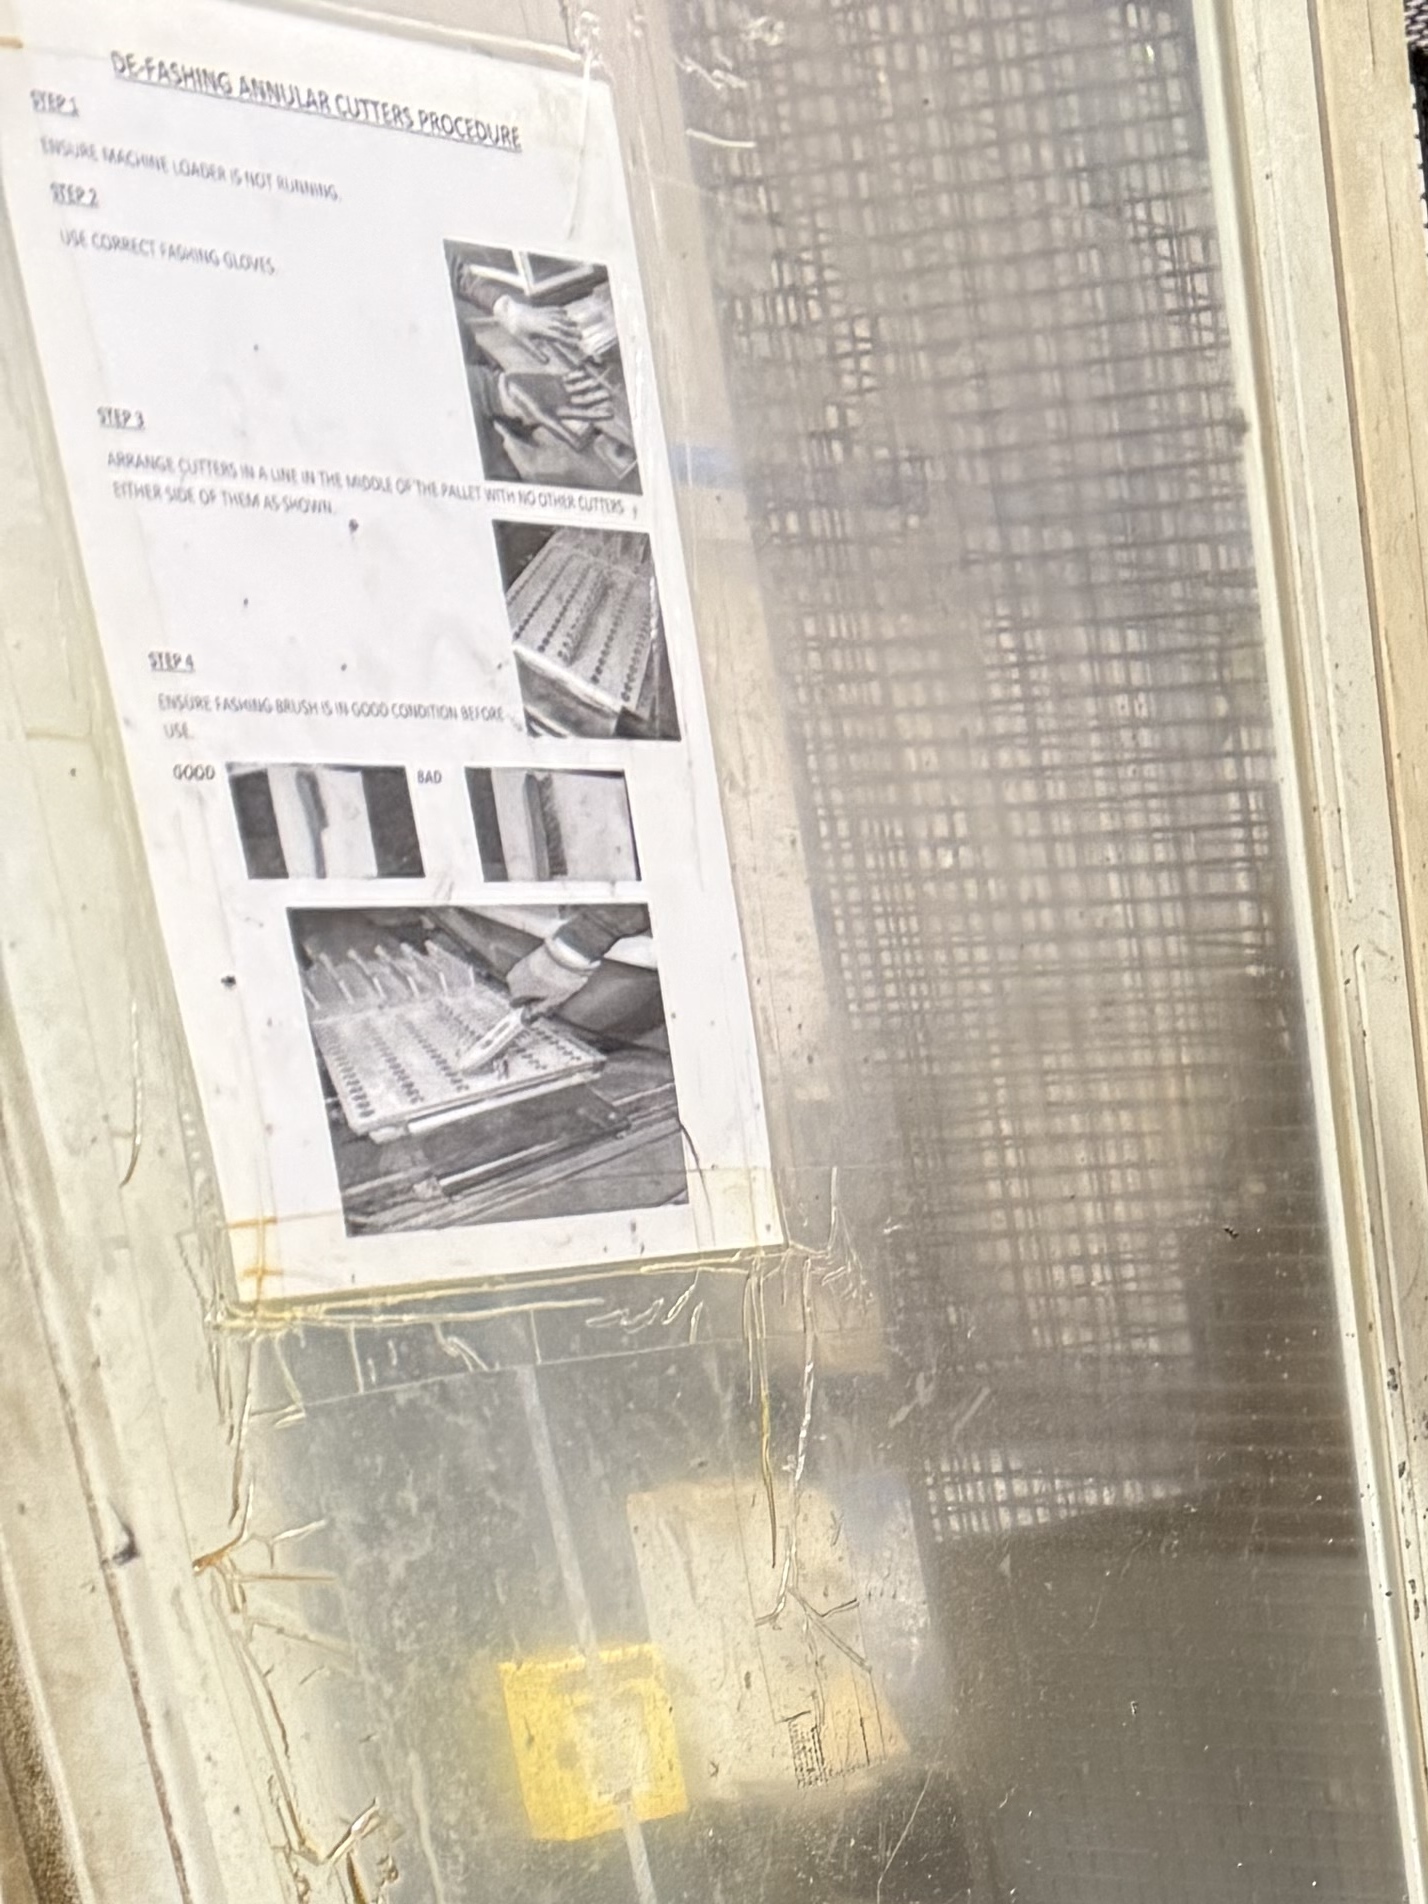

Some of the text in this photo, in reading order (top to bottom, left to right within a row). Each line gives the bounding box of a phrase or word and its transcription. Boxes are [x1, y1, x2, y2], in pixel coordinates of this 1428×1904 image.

[30, 89, 66, 113] STEP
[239, 76, 331, 113] ANNULAR
[334, 93, 414, 129] CUTTERS
[418, 109, 522, 150] PROCEDURE
[40, 137, 98, 162] ENSURE
[102, 146, 169, 174] MACHINE
[172, 158, 226, 182] LOADER
[230, 170, 241, 186] IS
[245, 171, 273, 192] NOT
[50, 181, 99, 206] STEP 2
[60, 227, 87, 248] USE
[91, 231, 156, 258] CORRECT
[96, 405, 145, 430] STEP 3
[107, 451, 175, 475] ARRANGE
[177, 457, 237, 480] CUTTERS
[240, 464, 255, 481] IN
[258, 466, 268, 482] A
[271, 467, 298, 485] LINE
[301, 469, 316, 486] IN
[318, 471, 343, 490] THE
[346, 475, 392, 494] MIDDLE
[395, 477, 412, 496] OF
[415, 479, 438, 498] THE
[440, 483, 481, 502] PALLET
[484, 487, 516, 505] WITH
[518, 490, 536, 506] NO
[538, 490, 576, 510] OTHER
[578, 498, 625, 515] CUTTERS
[113, 481, 162, 502] EITHER
[164, 486, 195, 504] SIDE
[200, 488, 217, 506] OF
[221, 492, 261, 510] THEM
[264, 495, 281, 512] AS
[148, 651, 195, 672] STEP 4
[158, 693, 212, 713] ENSURE
[275, 698, 319, 716] BRUSH
[322, 700, 333, 716] IS
[336, 700, 349, 716] IN
[351, 701, 390, 718] GOOD
[391, 702, 458, 721] CONDITION
[461, 704, 504, 722] BEFORE
[173, 764, 216, 781] GOOD
[416, 769, 443, 785] BAD
